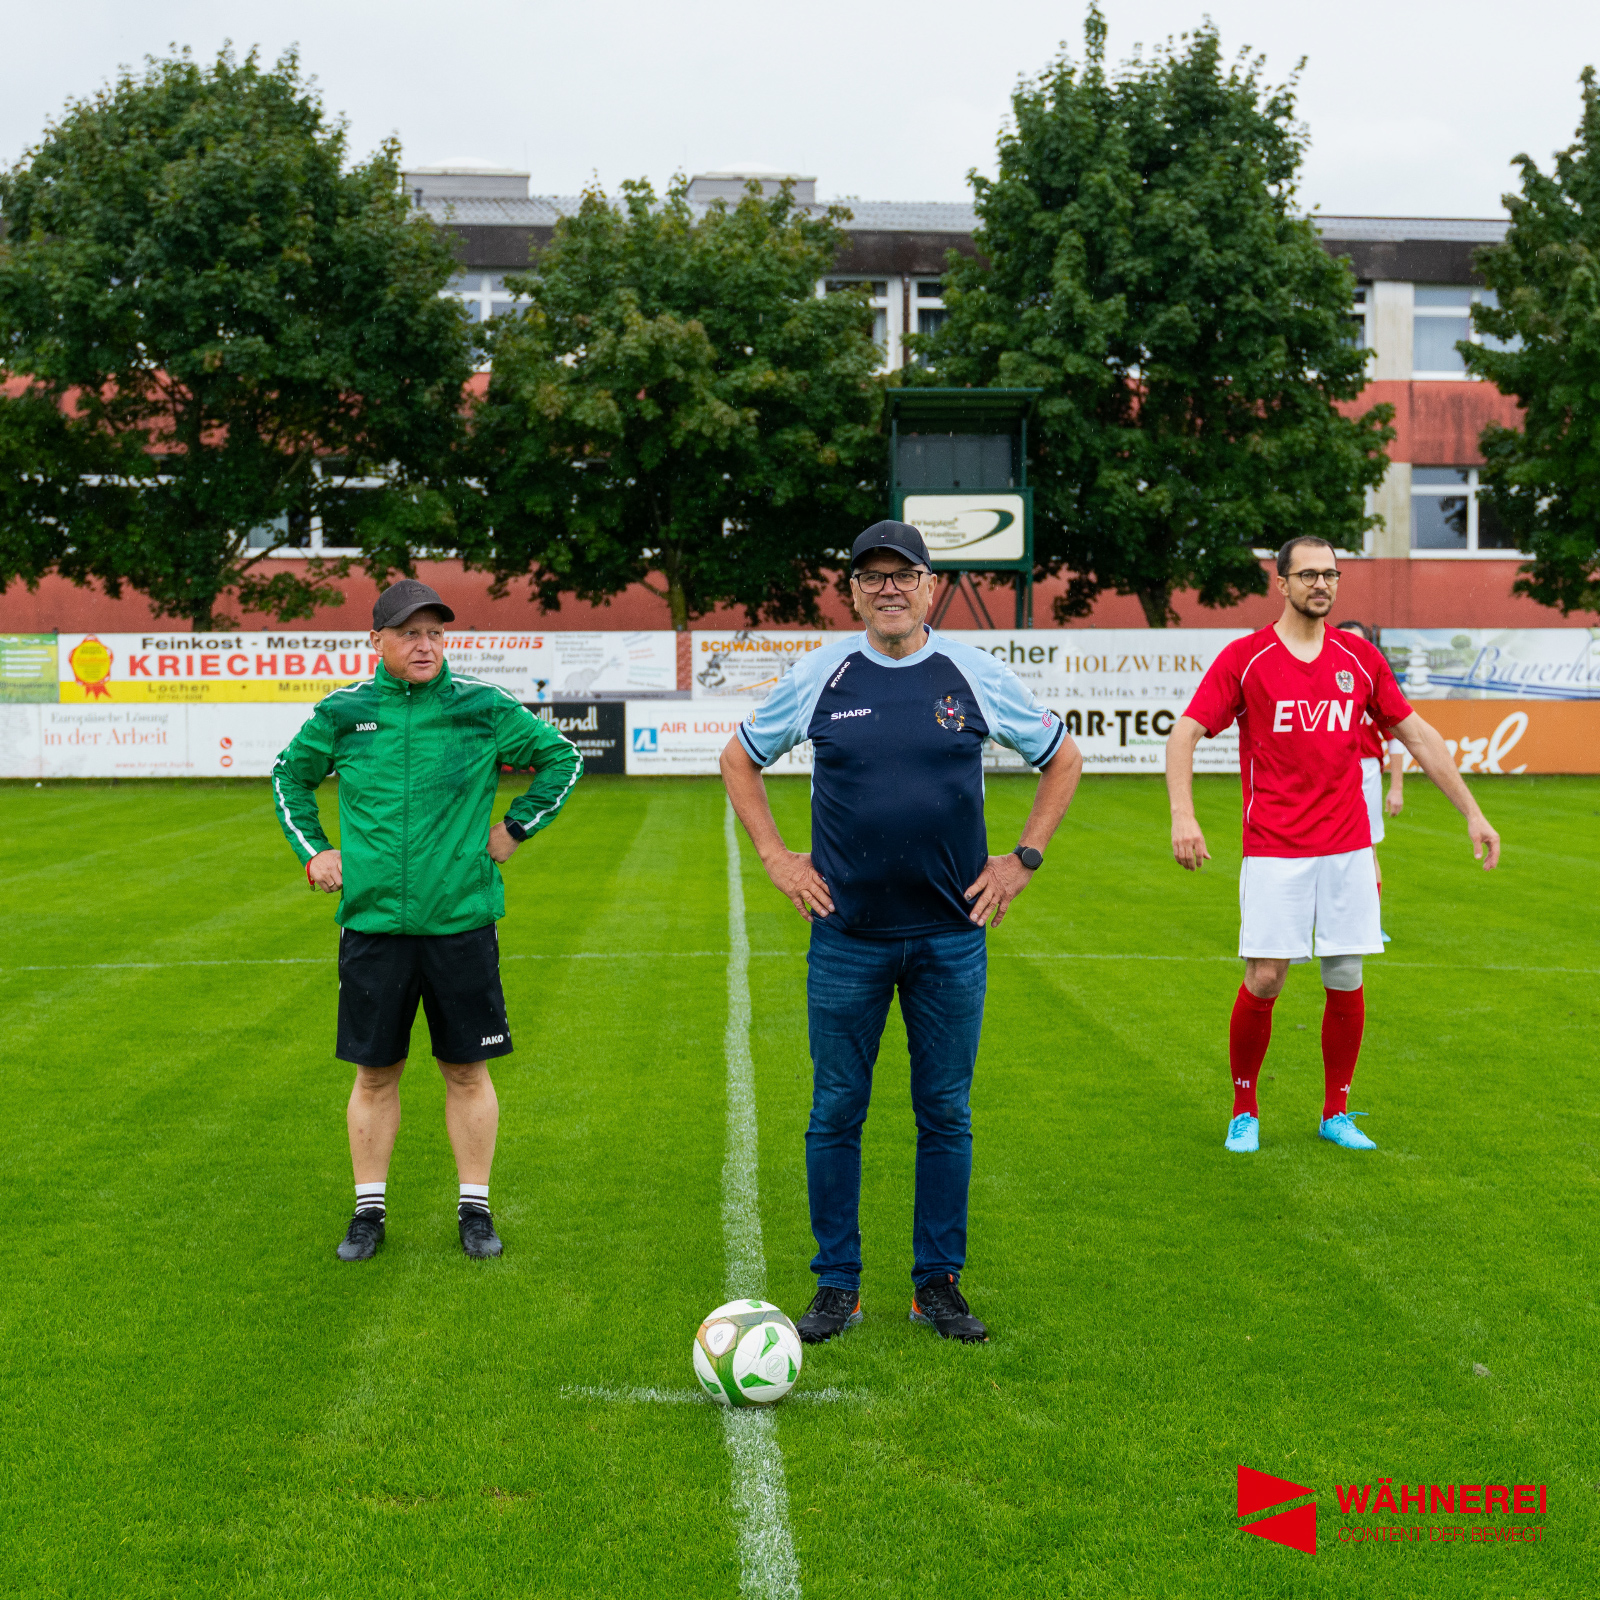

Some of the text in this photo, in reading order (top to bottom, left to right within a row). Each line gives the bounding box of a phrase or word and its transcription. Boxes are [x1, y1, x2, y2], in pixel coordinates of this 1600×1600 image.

[141, 636, 243, 650] Feinkost
[449, 653, 472, 661] DREI
[481, 652, 505, 663] Shop
[975, 640, 1059, 664] cher
[1065, 655, 1205, 673] HOLZWERK
[830, 661, 851, 688] STANNO
[148, 682, 210, 693] Lochen
[1090, 685, 1135, 697] Telefax
[51, 711, 169, 725] Europäische Lösung
[537, 706, 598, 731] llhendl
[830, 708, 872, 720] SHARP
[1272, 700, 1354, 733] EVN
[356, 722, 378, 732] JAKO
[661, 722, 741, 733] AIR LIQUI
[1051, 709, 1175, 747] AR-TEC
[44, 727, 168, 745] in der Arbeit
[480, 1034, 504, 1046] JAKO
